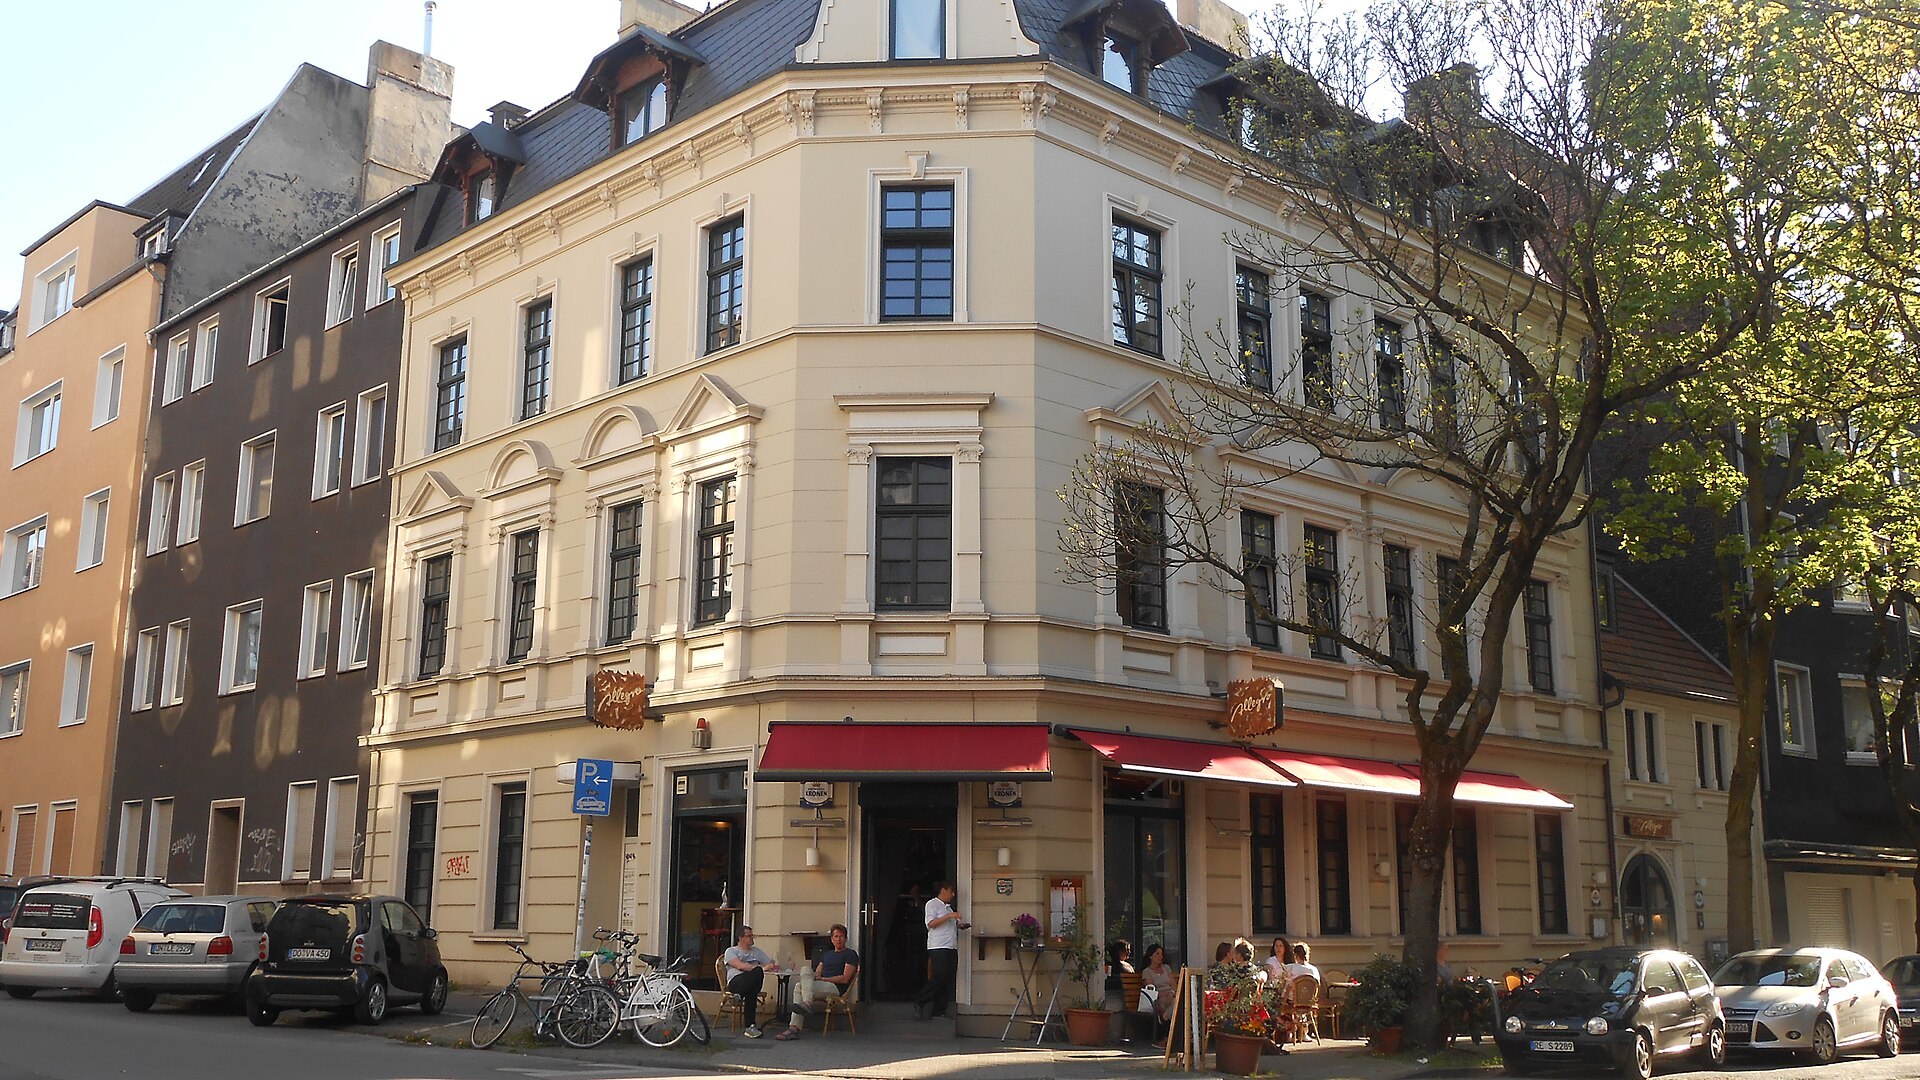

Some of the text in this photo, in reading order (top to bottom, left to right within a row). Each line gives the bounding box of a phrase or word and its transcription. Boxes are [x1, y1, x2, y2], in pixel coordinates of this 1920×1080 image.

[597, 686, 645, 712] Allegro
[1230, 687, 1272, 723] Allegro
[581, 762, 598, 784] P
